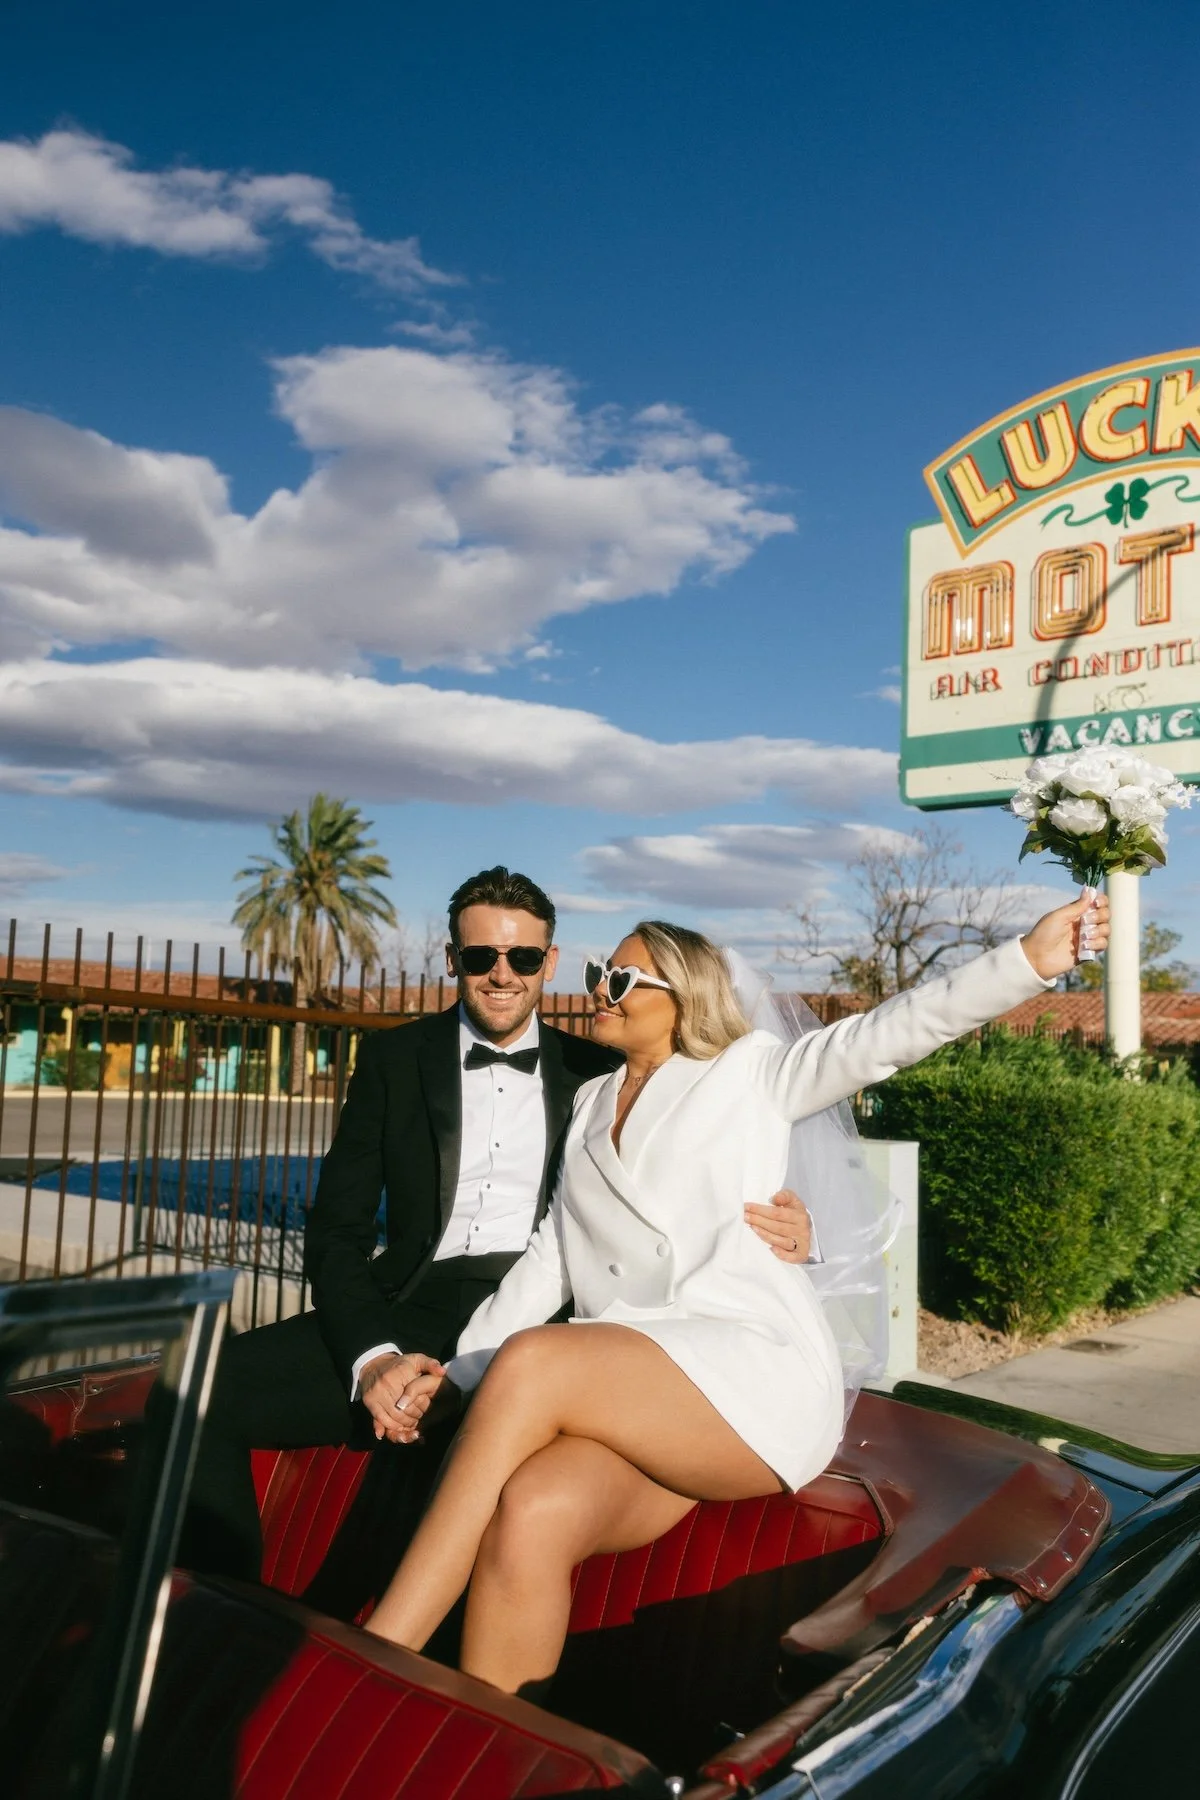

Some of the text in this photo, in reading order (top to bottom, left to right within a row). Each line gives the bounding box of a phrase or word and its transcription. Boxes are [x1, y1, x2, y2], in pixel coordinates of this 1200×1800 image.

[946, 370, 1200, 529] LUCK
[921, 523, 1195, 661] MOT
[932, 638, 1200, 699] AIR CONDIT
[1021, 709, 1200, 753] VACANC
